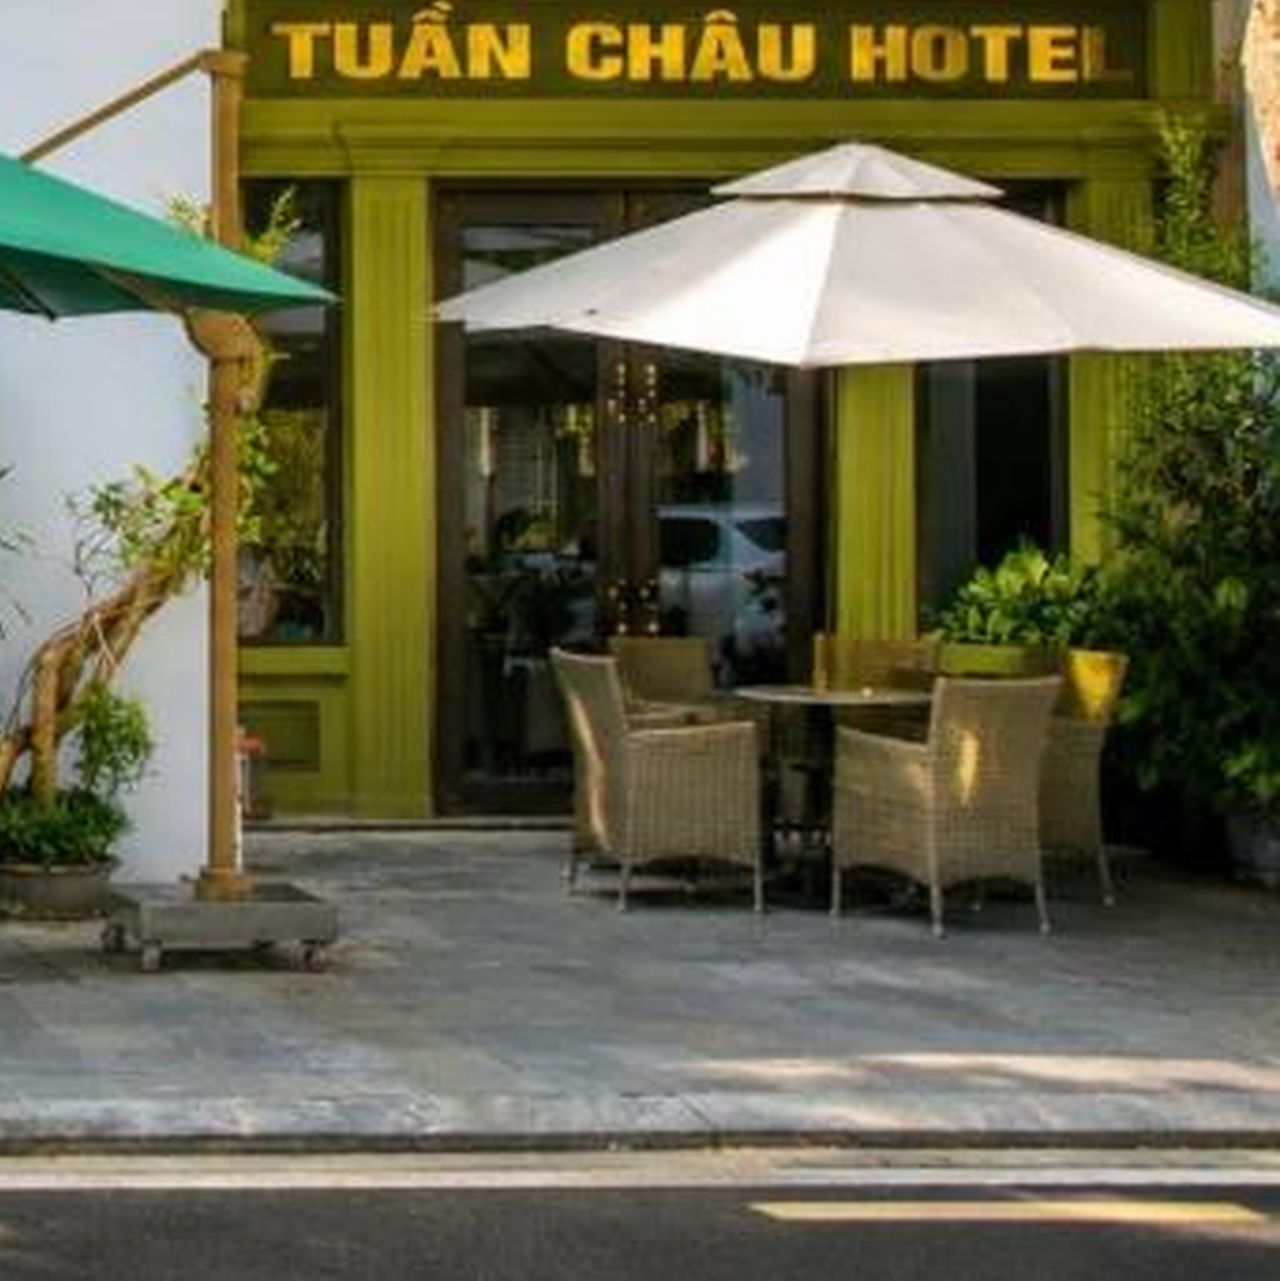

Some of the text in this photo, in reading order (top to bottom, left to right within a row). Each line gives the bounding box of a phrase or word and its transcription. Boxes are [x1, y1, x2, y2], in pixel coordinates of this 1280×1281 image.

[271, 0, 1133, 82] TUẦN CHÂU HOTEL
